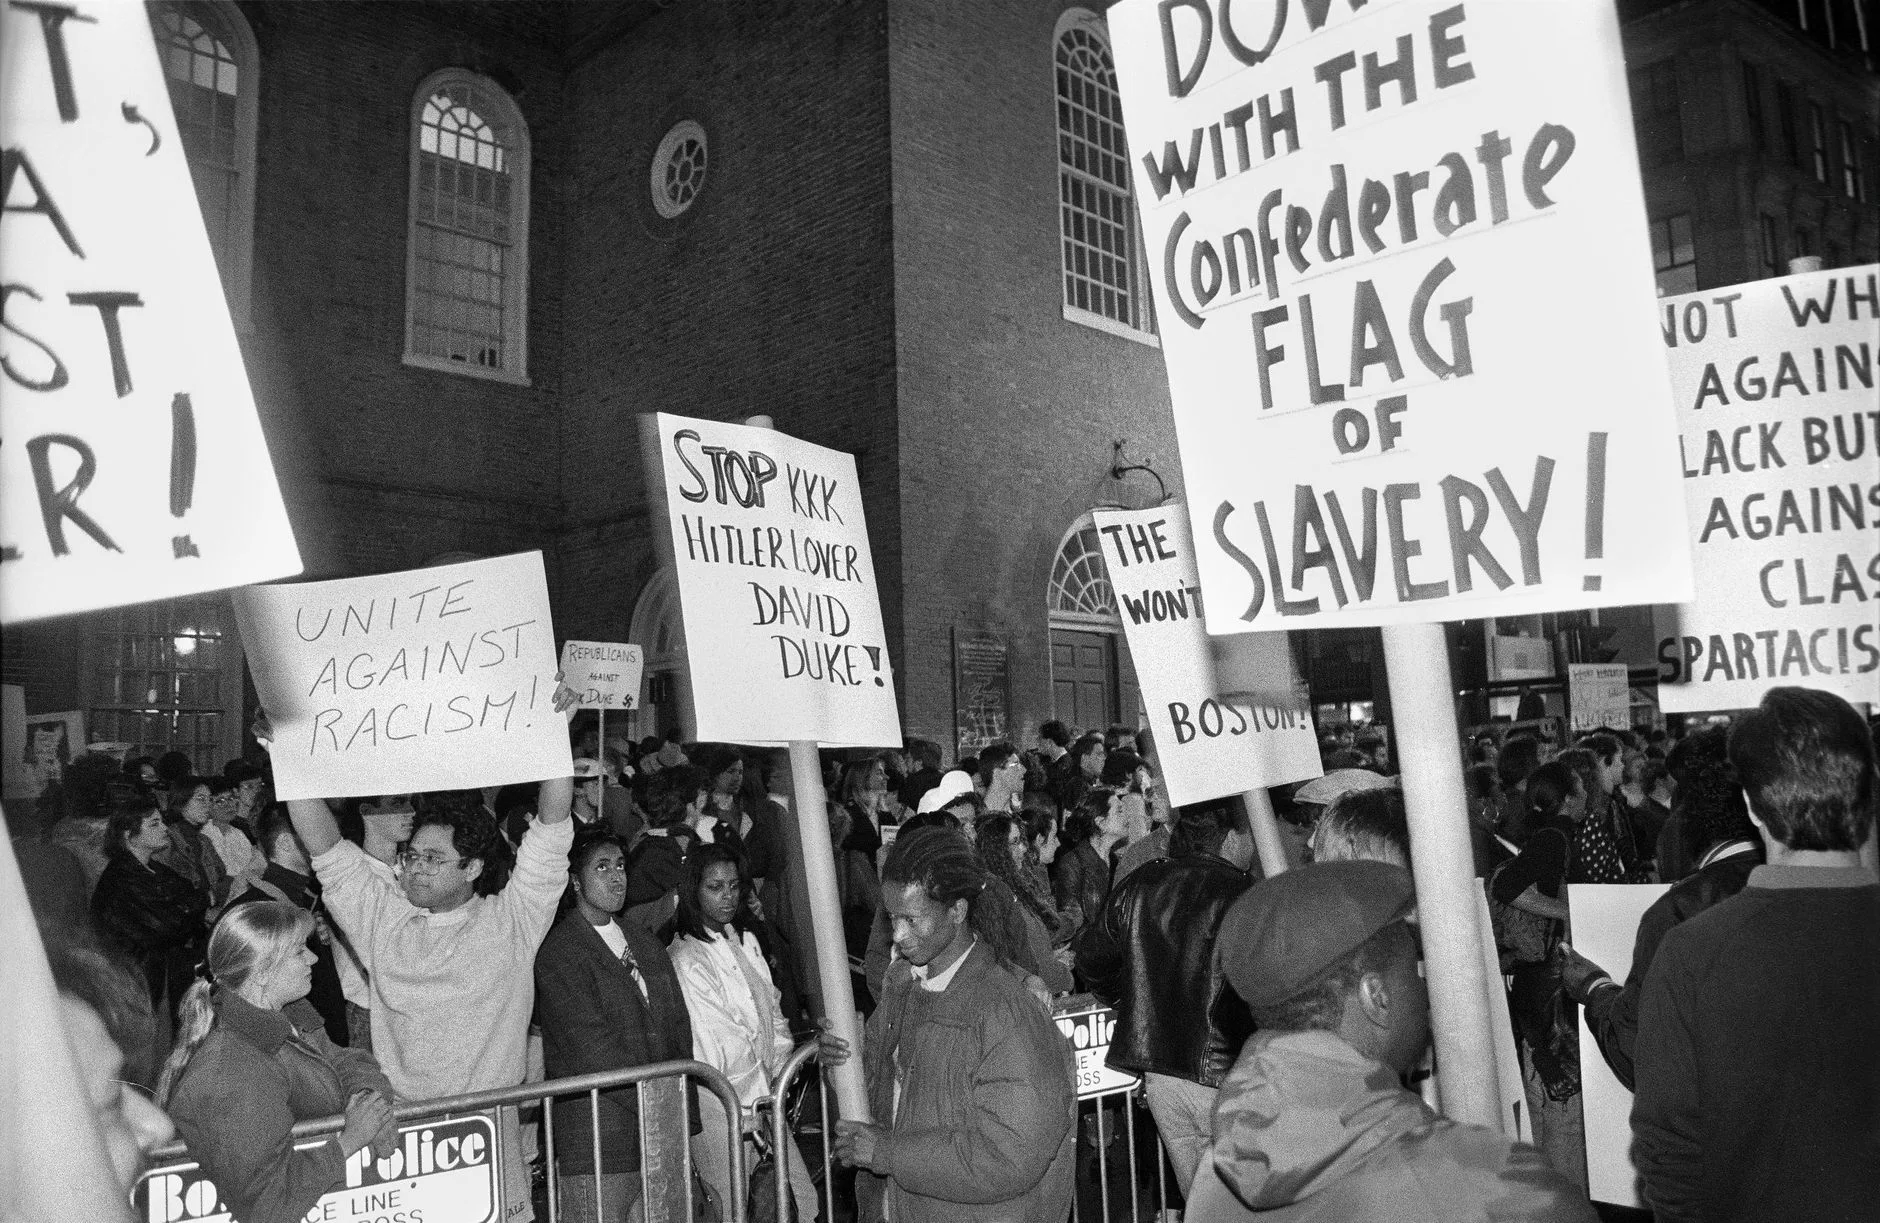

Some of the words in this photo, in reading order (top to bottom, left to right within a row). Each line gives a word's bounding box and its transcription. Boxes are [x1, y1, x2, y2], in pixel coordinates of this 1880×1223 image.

[1142, 87, 1301, 201] WITH
[1314, 3, 1476, 131] THE
[1164, 122, 1577, 330] Confederate
[1251, 257, 1475, 411] FLAG
[1780, 274, 1880, 328] WH
[1693, 342, 1880, 410] AGAIN
[1332, 395, 1408, 456] OF
[673, 428, 778, 509] STOP
[786, 463, 844, 525] KKK
[681, 514, 788, 570] HITLER
[791, 529, 863, 583] LOVER
[1101, 519, 1177, 567] THE
[1213, 432, 1609, 622] SLAVERY!
[296, 580, 474, 642] UNITE
[748, 582, 851, 637] DAVID
[309, 620, 536, 697] AGAINST
[568, 643, 637, 663] REPUBLICANS
[771, 635, 885, 687] DUKE!
[310, 676, 537, 756] RACISM!
[351, 1189, 401, 1216] LINE
